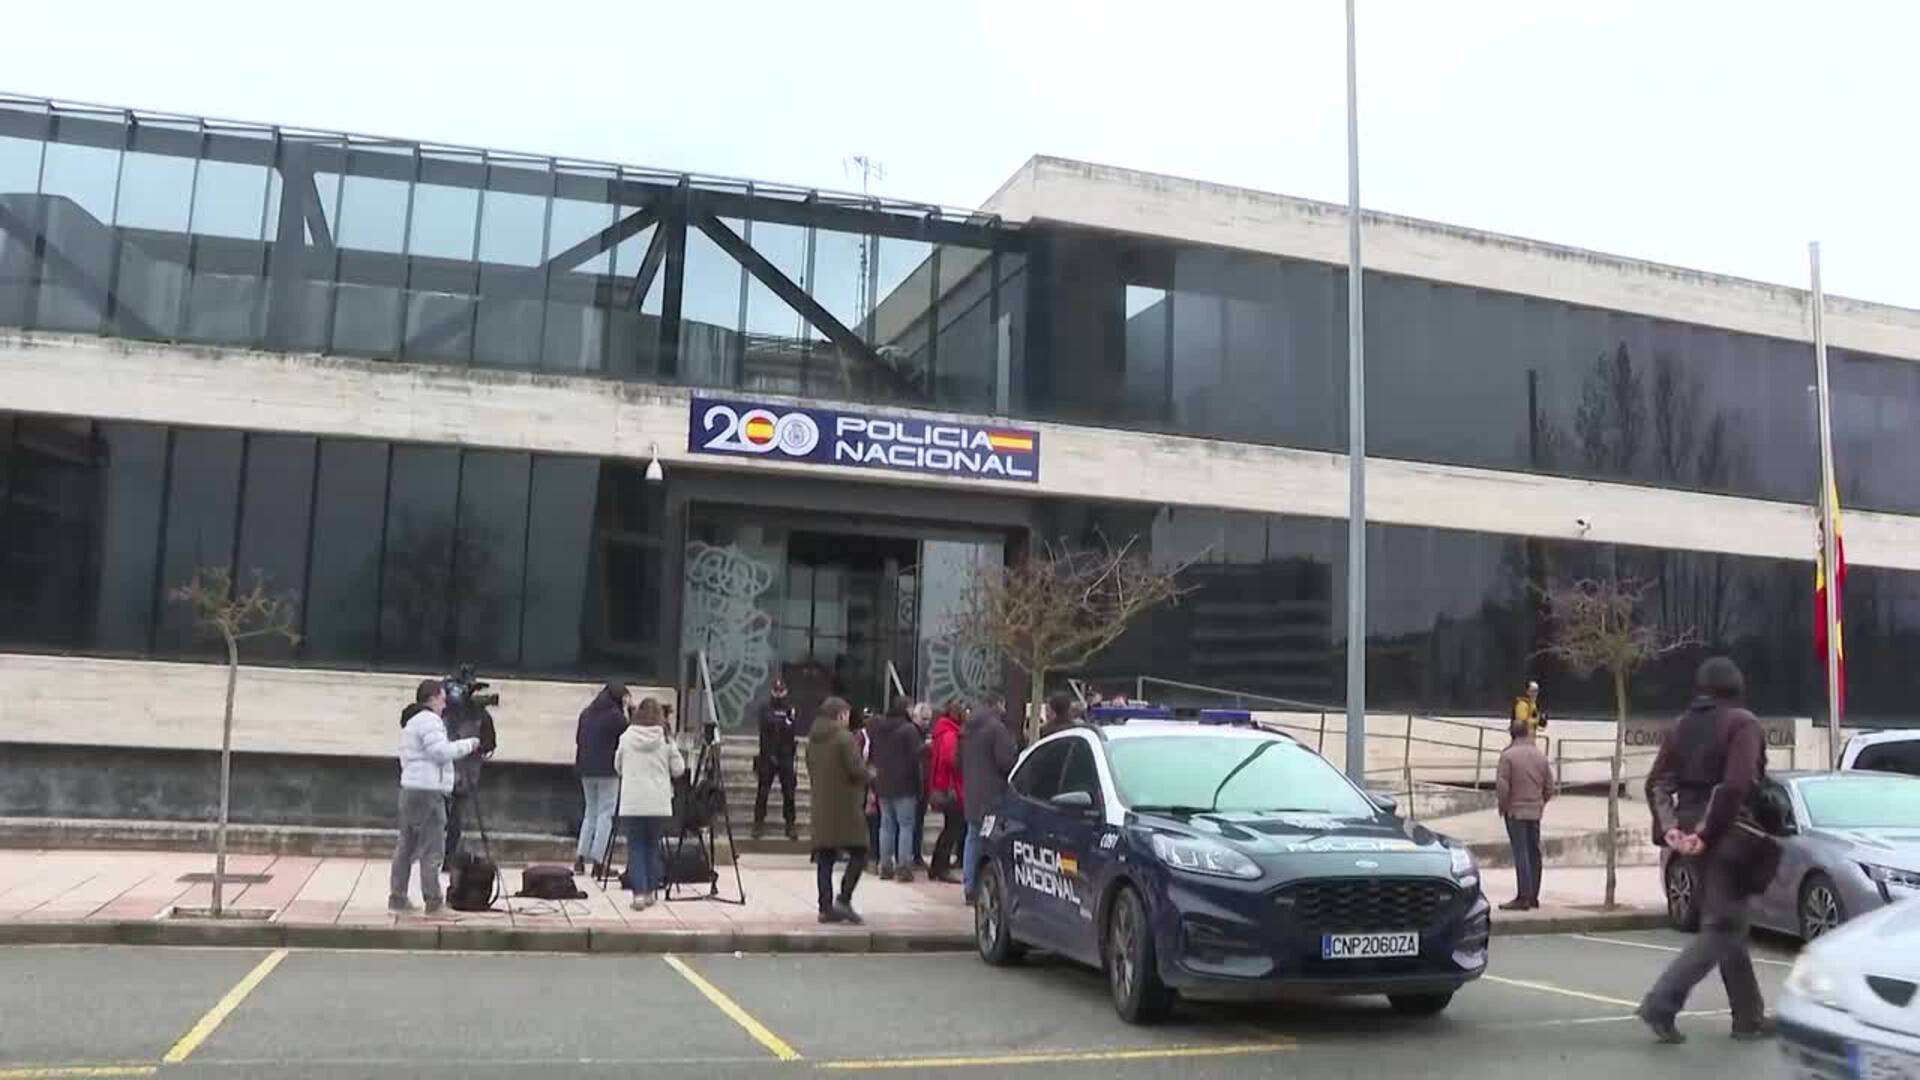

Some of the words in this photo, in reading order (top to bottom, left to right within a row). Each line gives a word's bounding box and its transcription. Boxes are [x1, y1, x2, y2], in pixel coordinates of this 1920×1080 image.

[703, 405, 819, 456] 200
[836, 416, 993, 450] POLICIA
[834, 440, 1033, 476] NACIONAL
[1013, 840, 1065, 875] POLICIA
[1014, 863, 1081, 905] NACIONAL
[1332, 935, 1416, 955] CNP2060ZA
